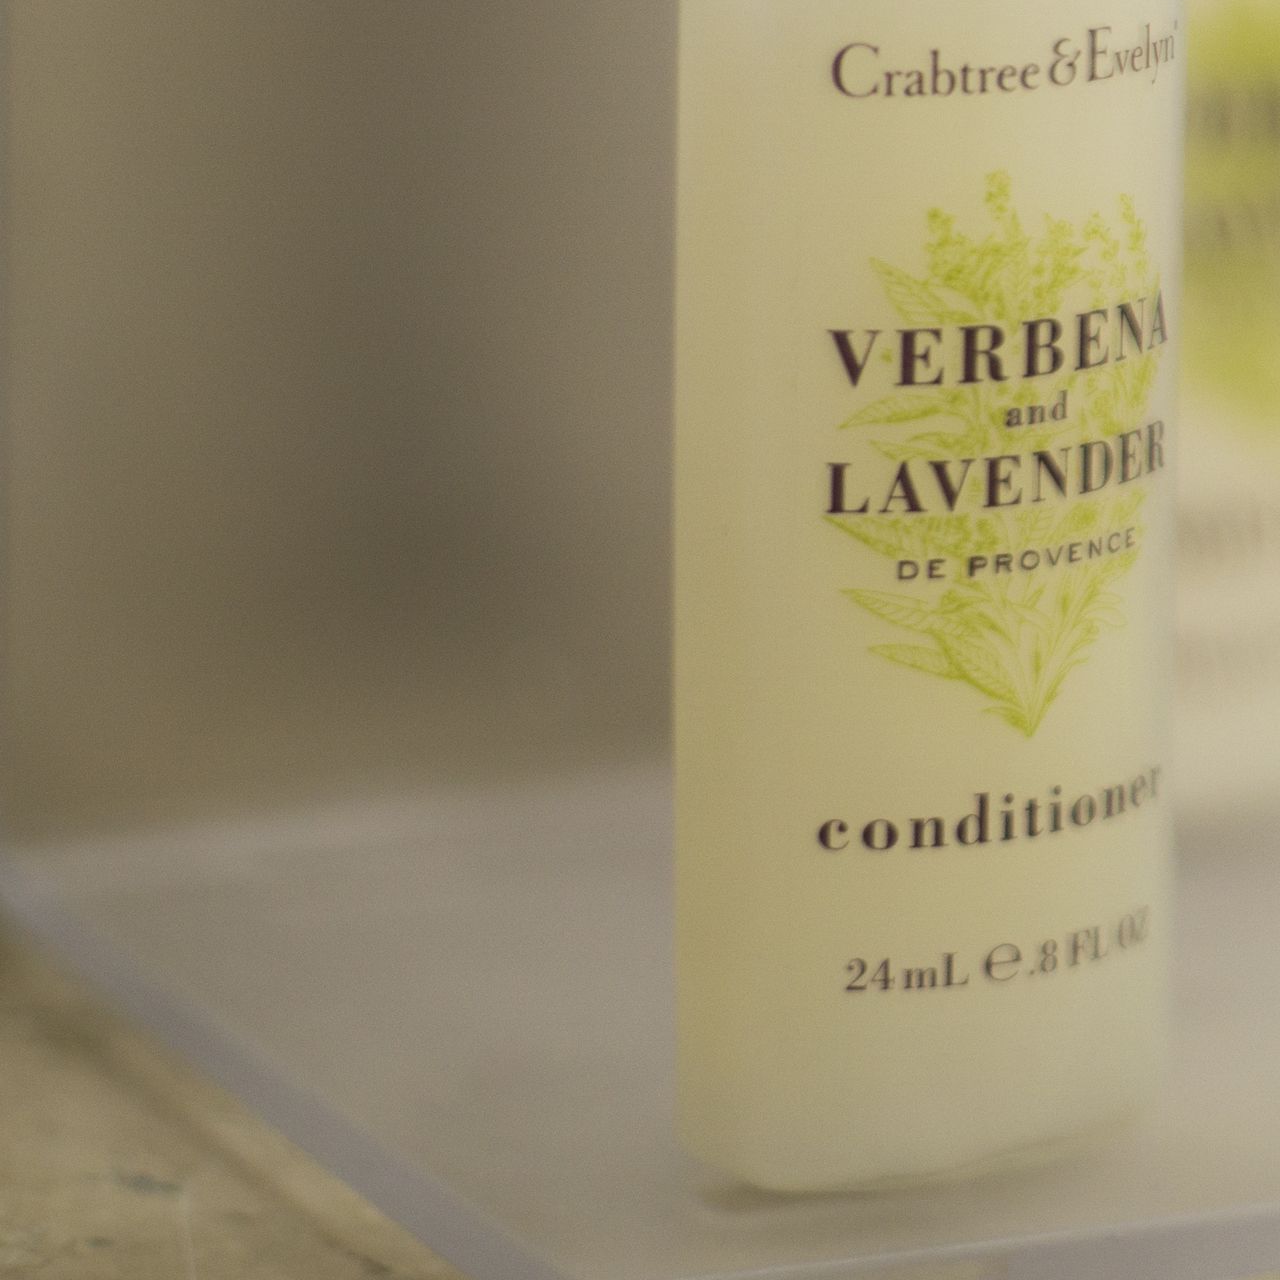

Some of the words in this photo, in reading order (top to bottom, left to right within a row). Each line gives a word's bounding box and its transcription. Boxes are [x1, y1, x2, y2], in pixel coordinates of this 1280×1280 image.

[831, 41, 1041, 98] Crabtree
[826, 287, 1169, 388] VERBENA
[1004, 388, 1069, 428] and
[824, 419, 1166, 516] LAVENDER
[897, 558, 947, 581] DE
[968, 526, 1137, 578] PROVENCE
[816, 764, 1162, 852] conditioner
